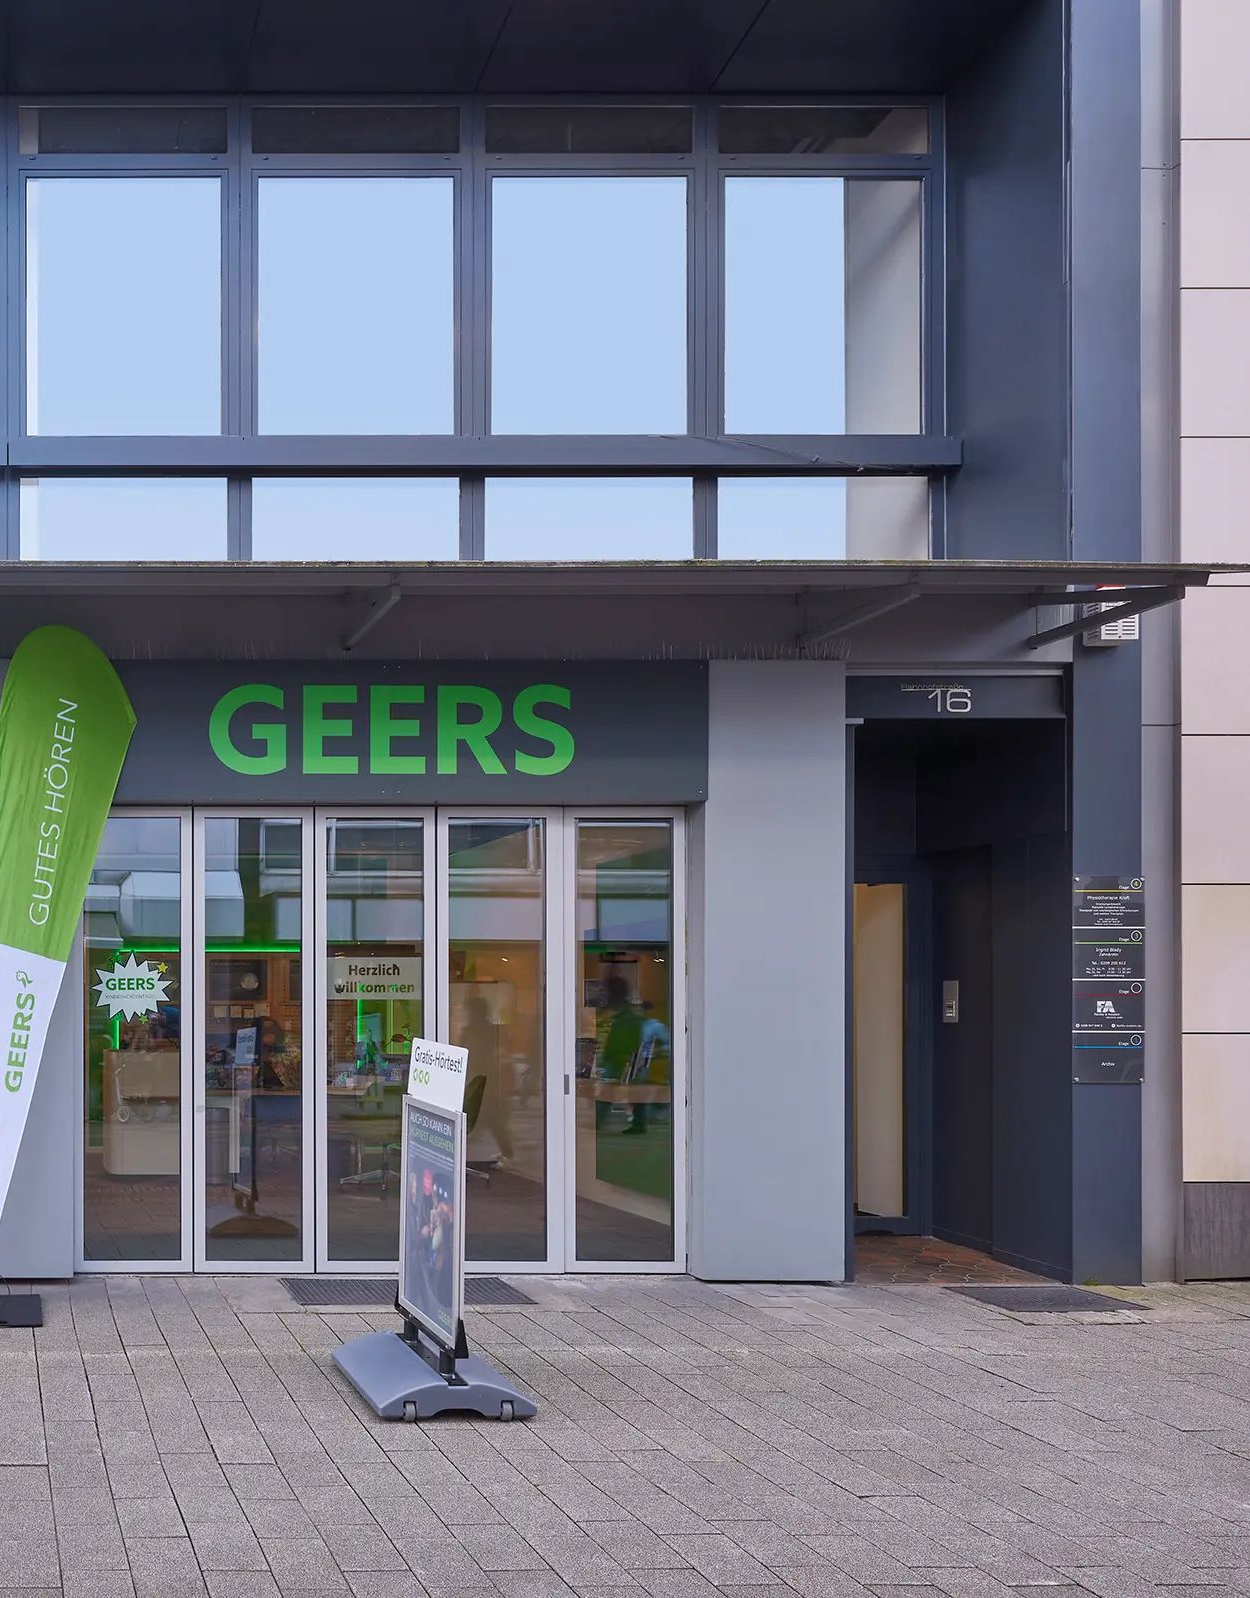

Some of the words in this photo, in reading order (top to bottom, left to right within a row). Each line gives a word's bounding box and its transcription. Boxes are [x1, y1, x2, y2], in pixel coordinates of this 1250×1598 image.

[928, 689, 972, 713] 16
[208, 683, 576, 776] GEERS
[42, 697, 78, 814] HÖREN
[29, 821, 61, 926] GUTES
[348, 963, 400, 976] Herzlich
[105, 977, 156, 991] GEERS
[334, 981, 415, 994] willkommen
[1096, 1000, 1116, 1013] FA
[4, 992, 36, 1093] GEERS
[414, 1046, 464, 1073] Gratis-Hörtest!
[443, 1123, 452, 1136] EIN
